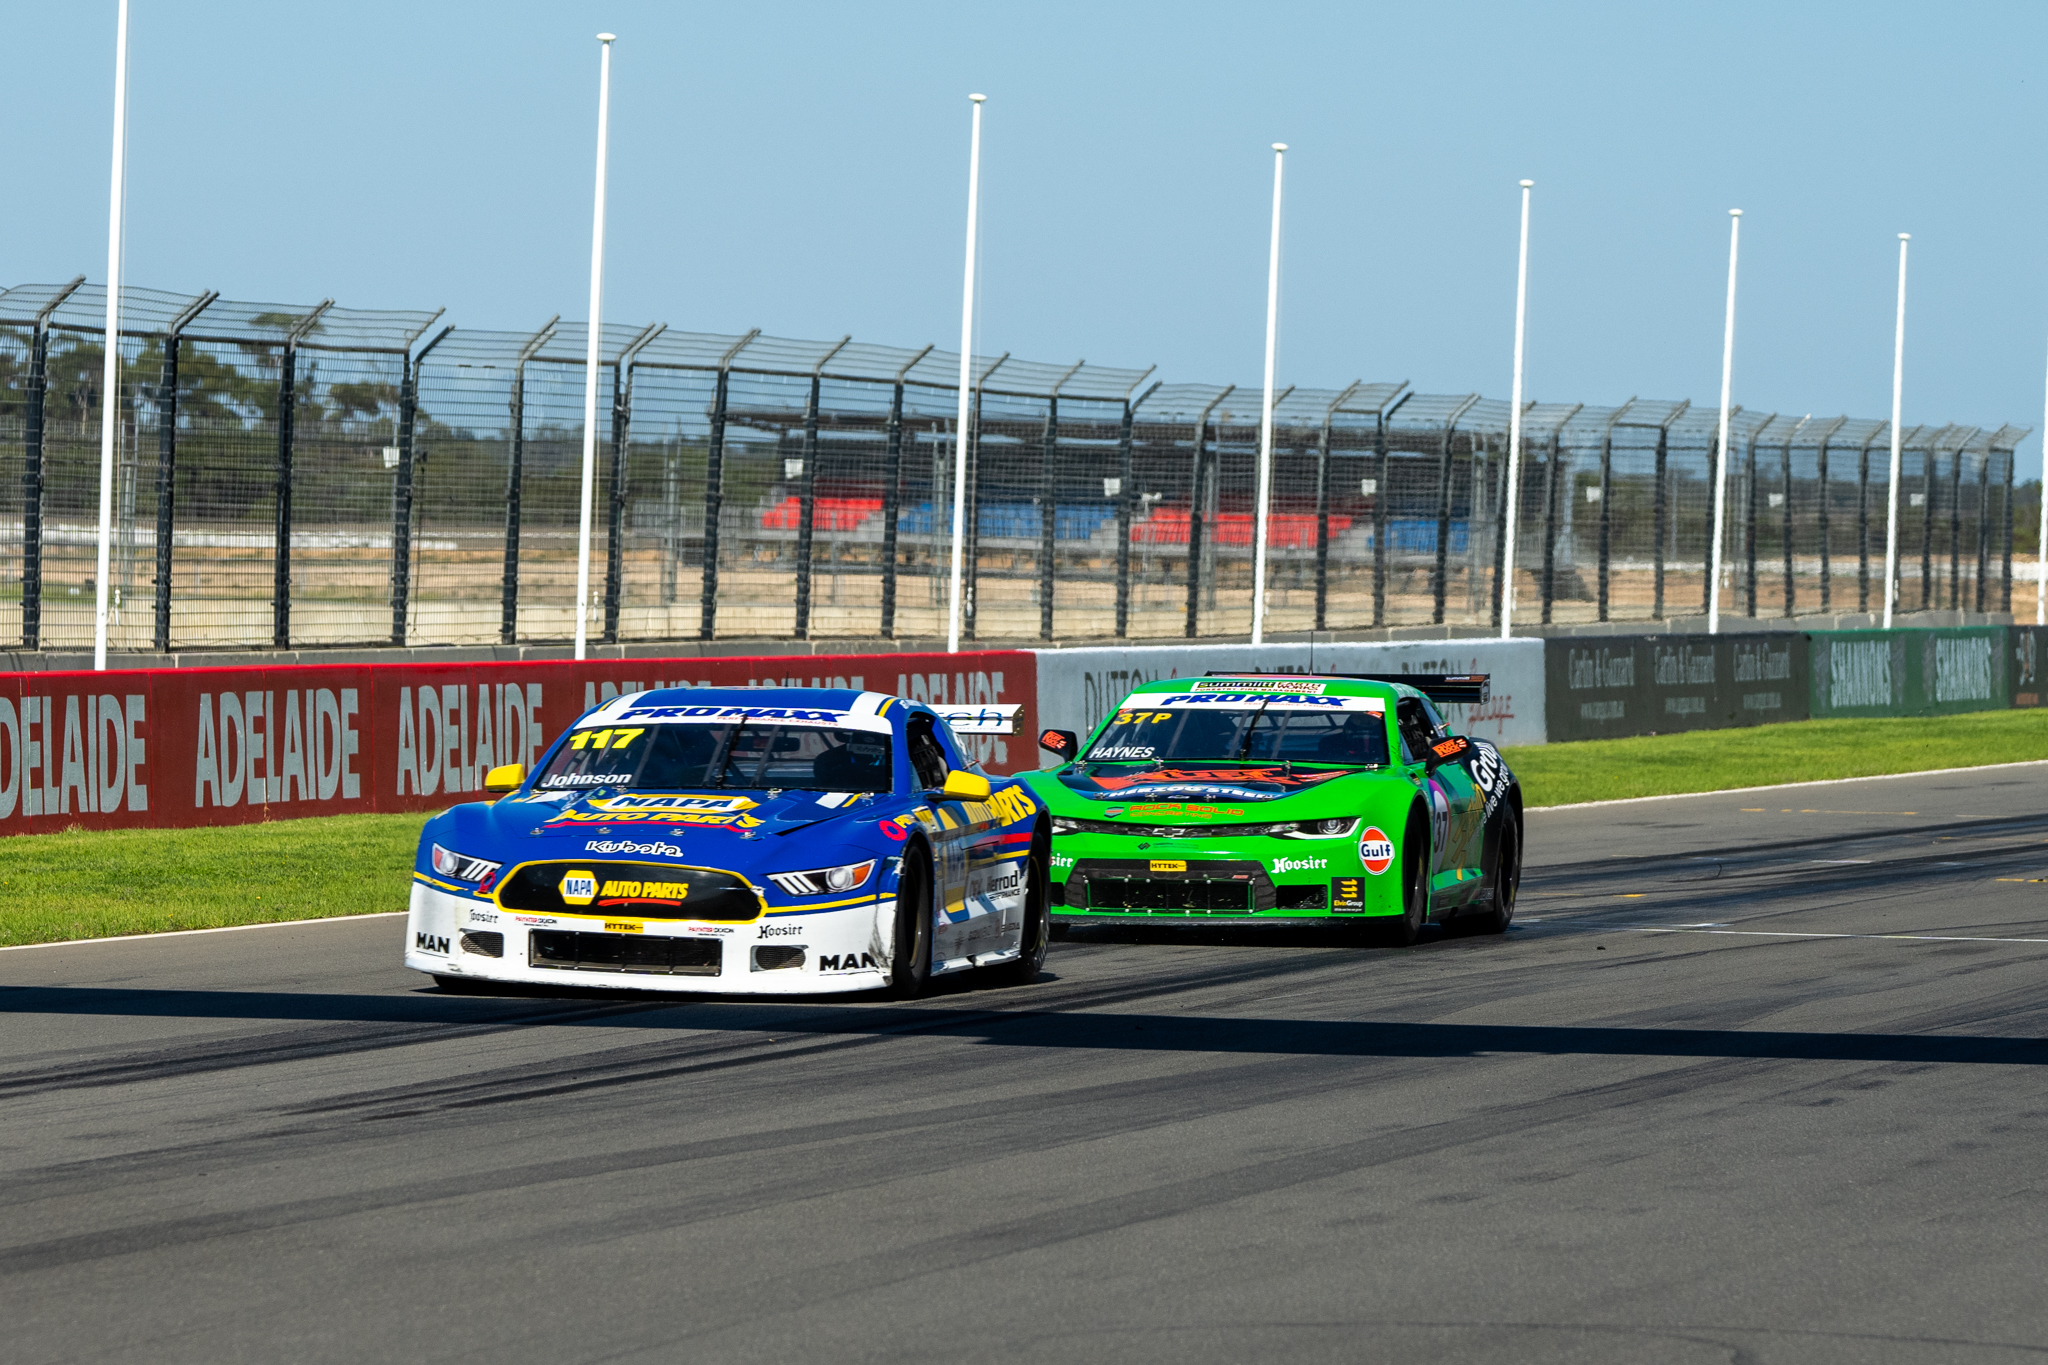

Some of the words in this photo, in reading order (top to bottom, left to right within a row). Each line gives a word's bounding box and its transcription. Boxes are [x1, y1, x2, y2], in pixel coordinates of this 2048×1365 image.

[195, 687, 361, 808] ADELAIDE
[397, 683, 544, 796] ADELAIDE
[569, 728, 645, 749] 117
[1089, 747, 1155, 758] HAYNES
[541, 774, 632, 787] Johnson
[612, 796, 731, 809] NAPA
[1129, 803, 1181, 811] ROCK
[1186, 804, 1244, 816] SOLID
[544, 809, 650, 823] AUTO
[649, 812, 765, 828] PARTS
[1130, 811, 1212, 819] CONCRETING
[1433, 811, 1448, 853] 37
[585, 840, 684, 857] Kubota
[1361, 842, 1391, 858] Gulf
[1270, 855, 1328, 874] Hoosier
[566, 880, 592, 896] NAPA
[600, 880, 642, 897] AUTO
[641, 882, 689, 899] PARTS
[605, 922, 636, 931] HYTEK
[757, 923, 803, 939] Hoosier
[416, 931, 450, 954] MAN
[819, 951, 879, 971] MAN
